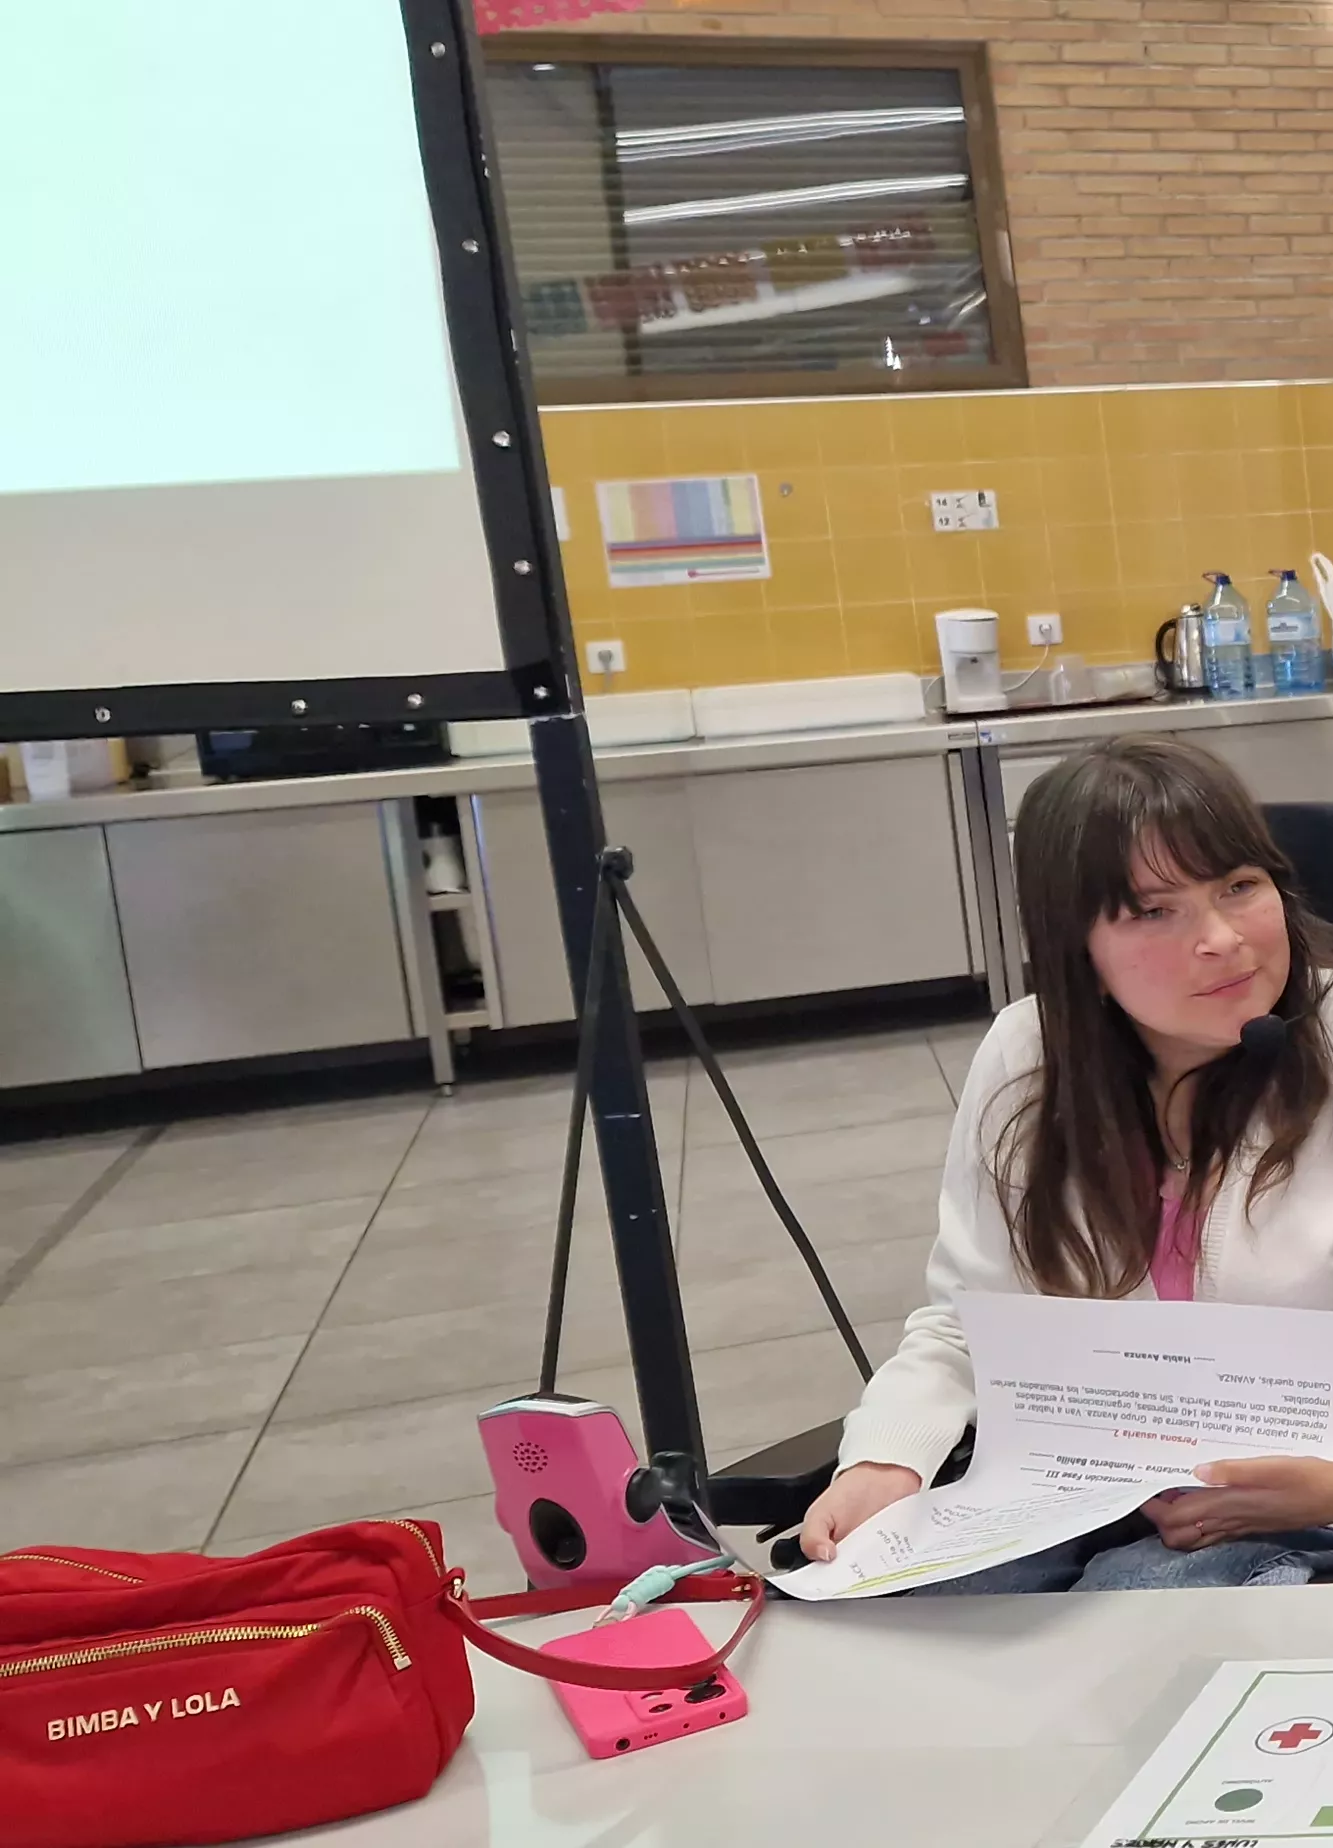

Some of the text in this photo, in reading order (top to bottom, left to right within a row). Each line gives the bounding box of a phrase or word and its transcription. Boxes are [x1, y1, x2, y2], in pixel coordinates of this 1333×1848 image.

[1123, 1351, 1191, 1364] Habla Avanza
[1019, 1381, 1064, 1393] resultados
[1258, 1375, 1295, 1389] queráis,
[1296, 1379, 1331, 1392] Cuando
[1066, 1384, 1079, 1395] los
[1082, 1385, 1140, 1400] aportaciones,
[1142, 1391, 1158, 1402] sus
[1159, 1393, 1174, 1404] Sin
[1177, 1395, 1211, 1408] Marcha.
[1014, 1401, 1025, 1411] en
[1027, 1401, 1055, 1414] hablar
[1057, 1405, 1063, 1413] a
[1213, 1398, 1247, 1410] nuestra
[1249, 1402, 1266, 1412] con
[1015, 1391, 1328, 1431] representación de las más de 140 empresas, organizaciones y entidades
[1065, 1406, 1082, 1417] Van
[1268, 1403, 1330, 1419] colaboradoras
[1120, 1412, 1147, 1425] Grupo
[1152, 1416, 1163, 1426] de
[1165, 1417, 1200, 1430] Lasierra
[1202, 1421, 1233, 1433] Ramón
[1235, 1425, 1254, 1436] José
[1113, 1428, 1198, 1446] Persona usuaria 2
[1256, 1427, 1289, 1440] palabra
[1291, 1431, 1299, 1441] la
[1301, 1432, 1324, 1444] Tiene
[1089, 1458, 1135, 1471] Humberto
[1045, 1469, 1061, 1479] III
[1062, 1471, 1083, 1481] Fase
[47, 1687, 241, 1742] BIMBA Y LOLA
